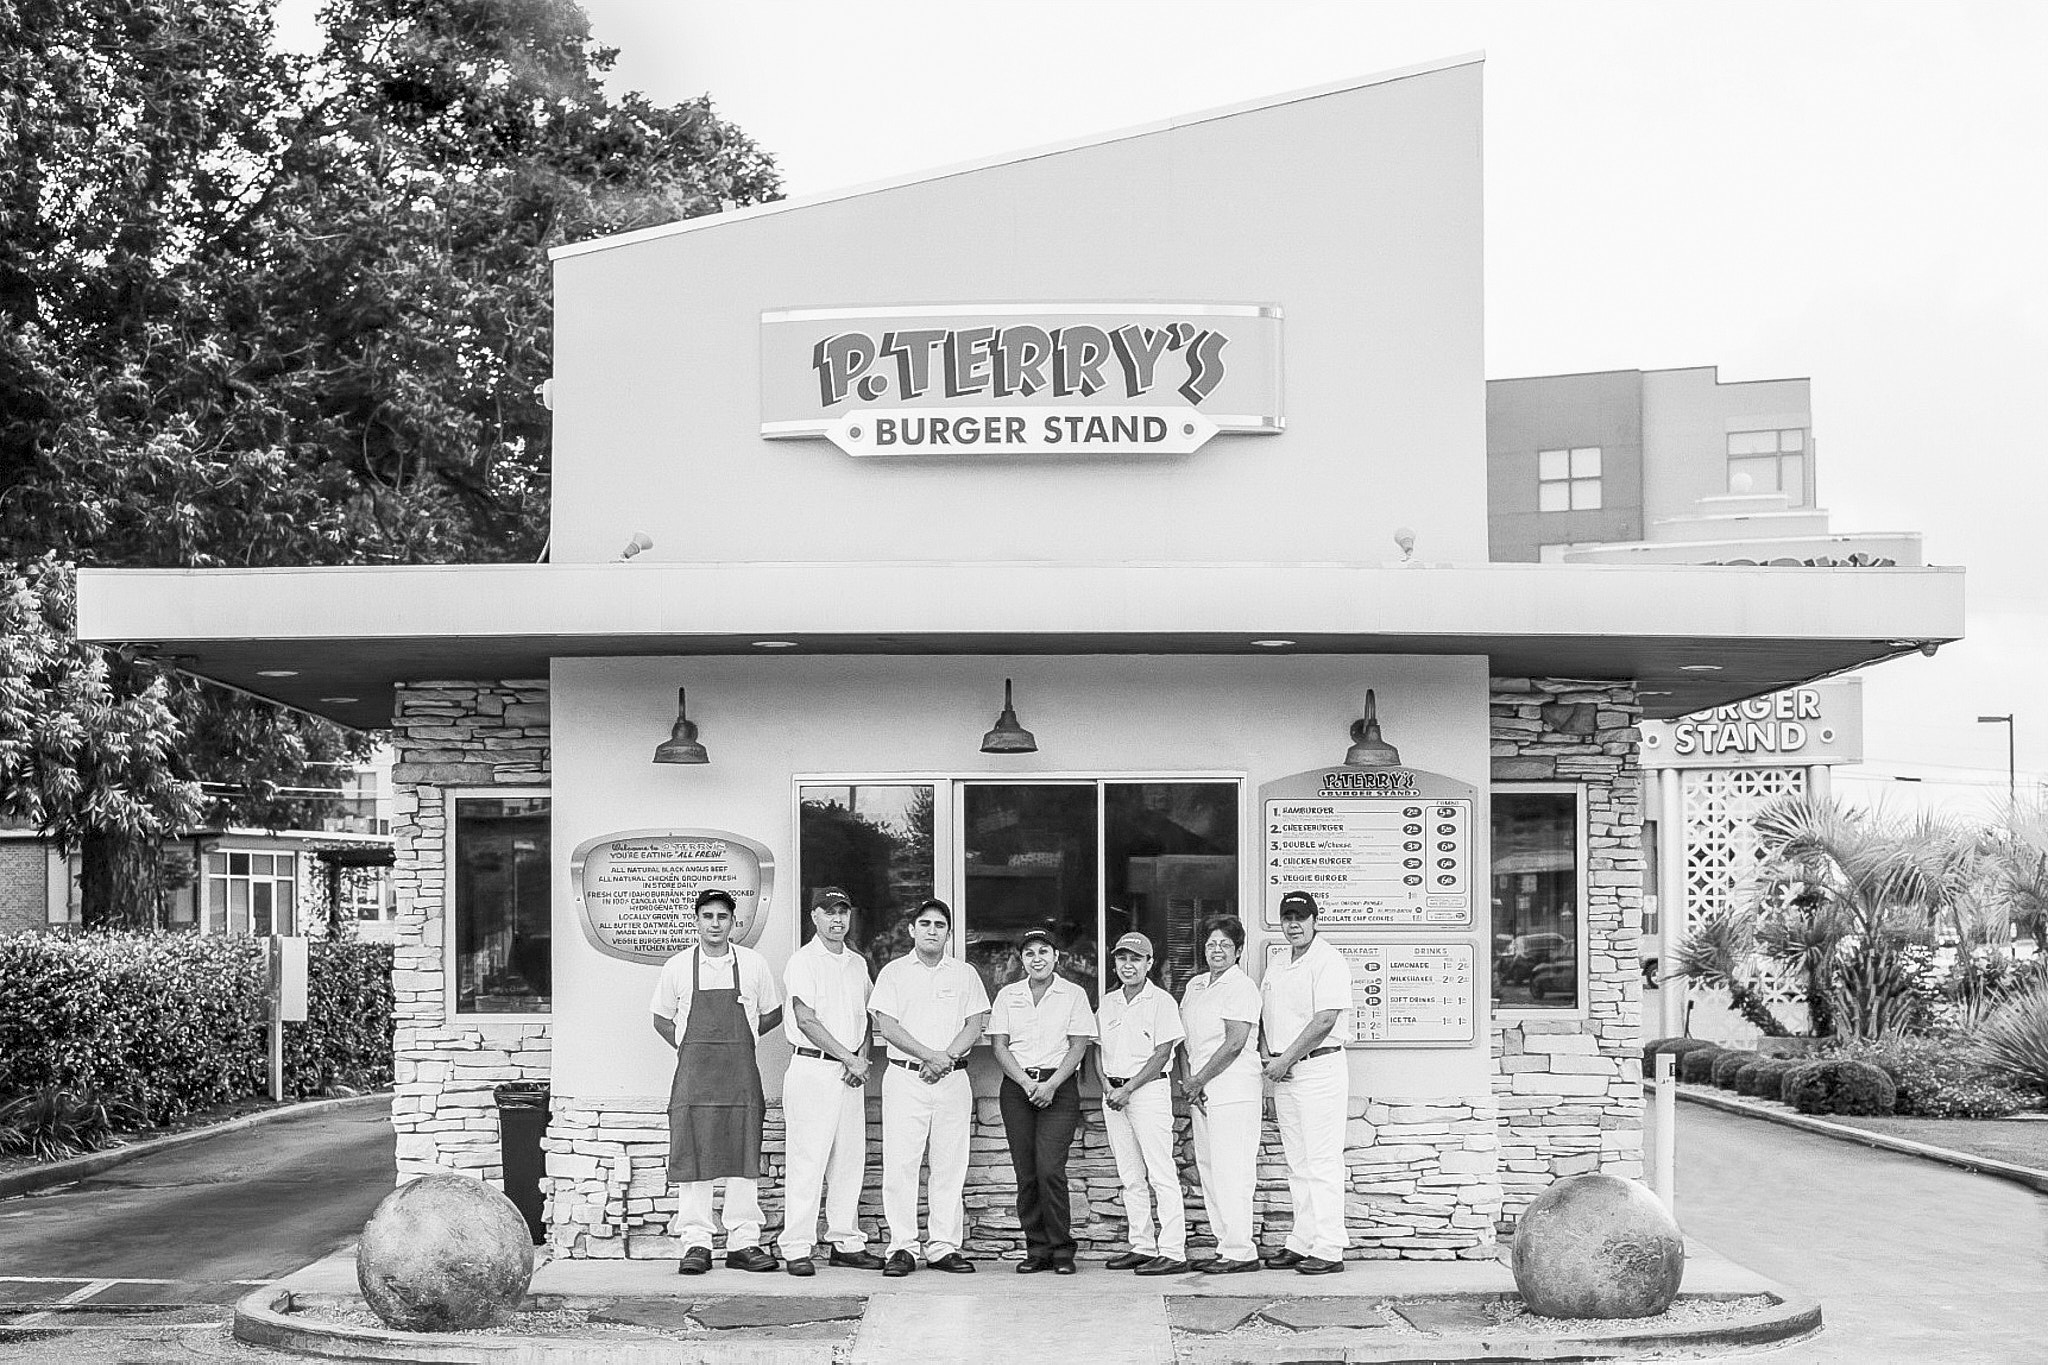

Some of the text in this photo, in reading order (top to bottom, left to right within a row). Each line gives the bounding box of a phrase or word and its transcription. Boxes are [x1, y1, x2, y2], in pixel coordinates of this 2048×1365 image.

[812, 322, 1230, 407] P.TERRY'S
[876, 415, 1168, 446] BURGER STAND
[1663, 688, 1821, 722] RGER
[1674, 722, 1807, 754] STAND
[1322, 770, 1416, 789] P.TERRY'S
[1282, 806, 1335, 815] HAMBURGER
[1270, 824, 1344, 834] 2. CHEESEBURGER
[1270, 841, 1282, 851] 3.
[1282, 841, 1316, 849] DOUBLE
[641, 851, 674, 859] EATING
[1270, 857, 1352, 867] 4. CHICKEN BURGER
[1270, 874, 1348, 885] 5. VEGGIE BURGER
[618, 913, 651, 921] LOCALLY
[634, 944, 666, 952] KITCHEN
[1414, 947, 1448, 955] DRINKS
